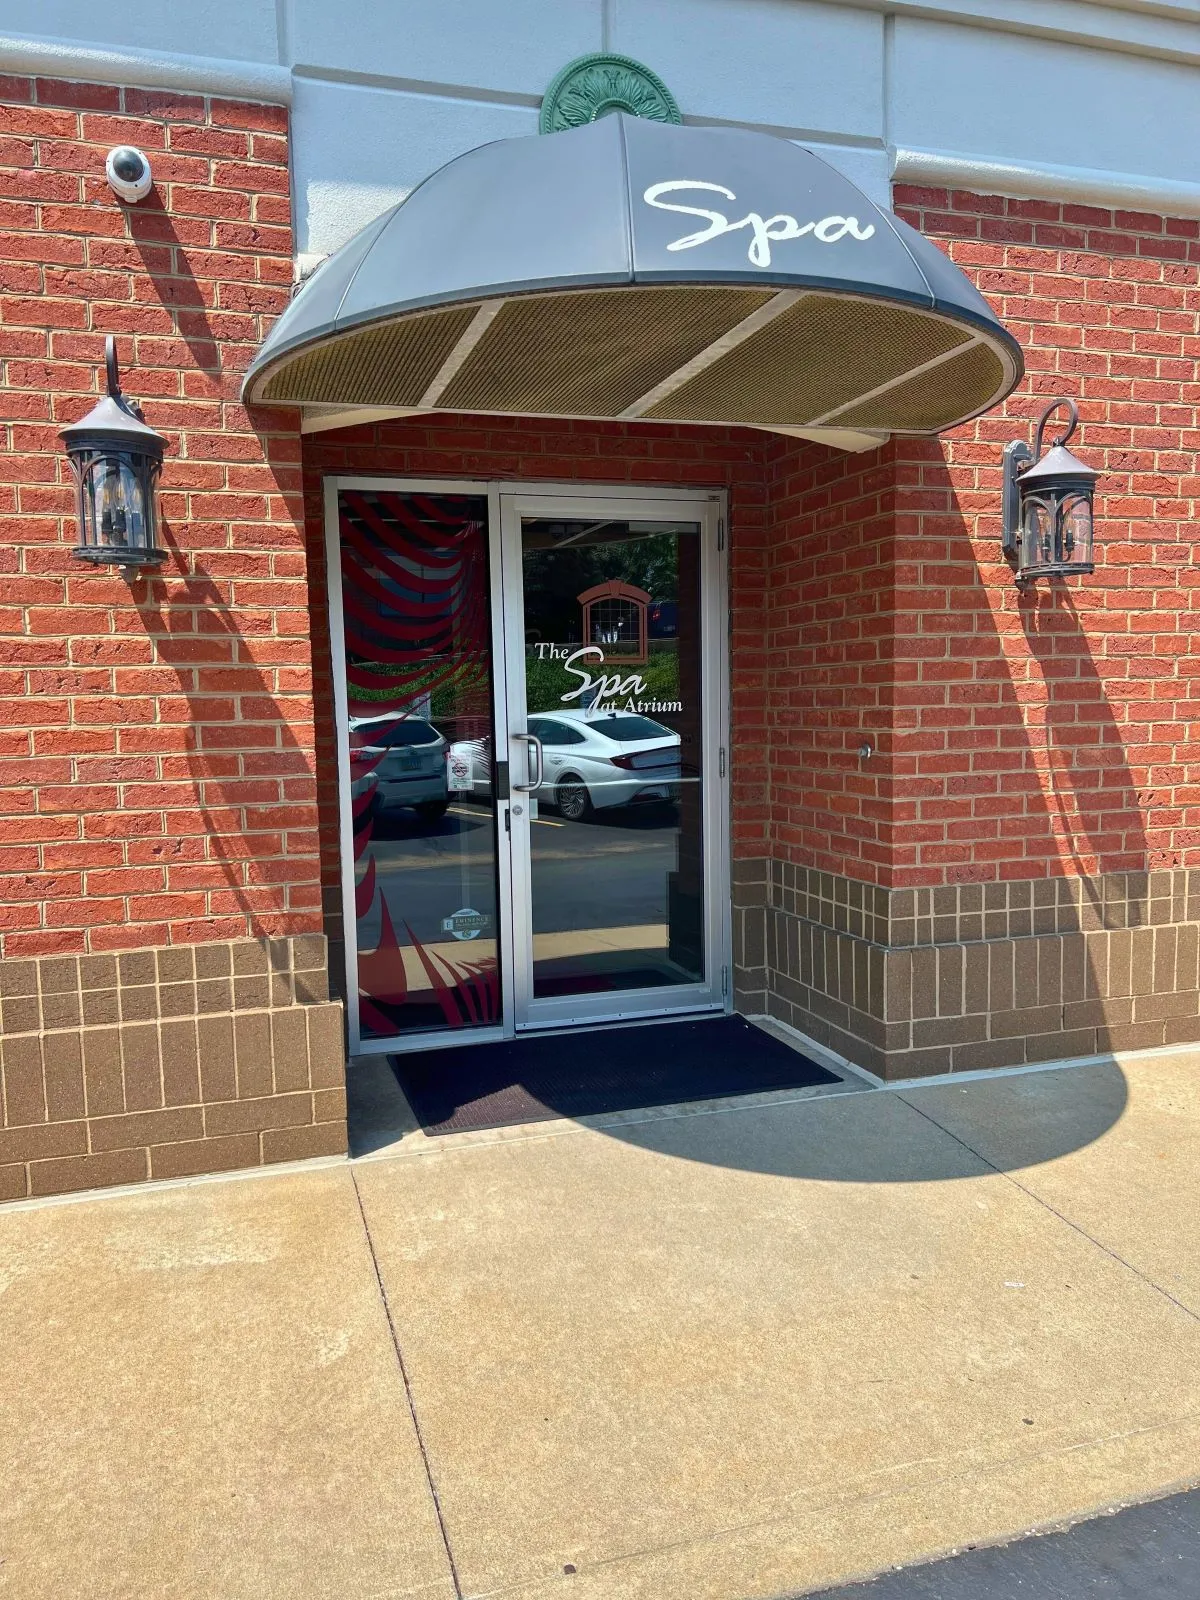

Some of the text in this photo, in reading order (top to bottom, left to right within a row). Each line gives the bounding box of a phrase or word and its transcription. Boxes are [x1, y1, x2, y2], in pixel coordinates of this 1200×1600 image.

[643, 180, 876, 267] Spa
[534, 642, 648, 718] The Spa
[600, 696, 683, 713] at Atrium
